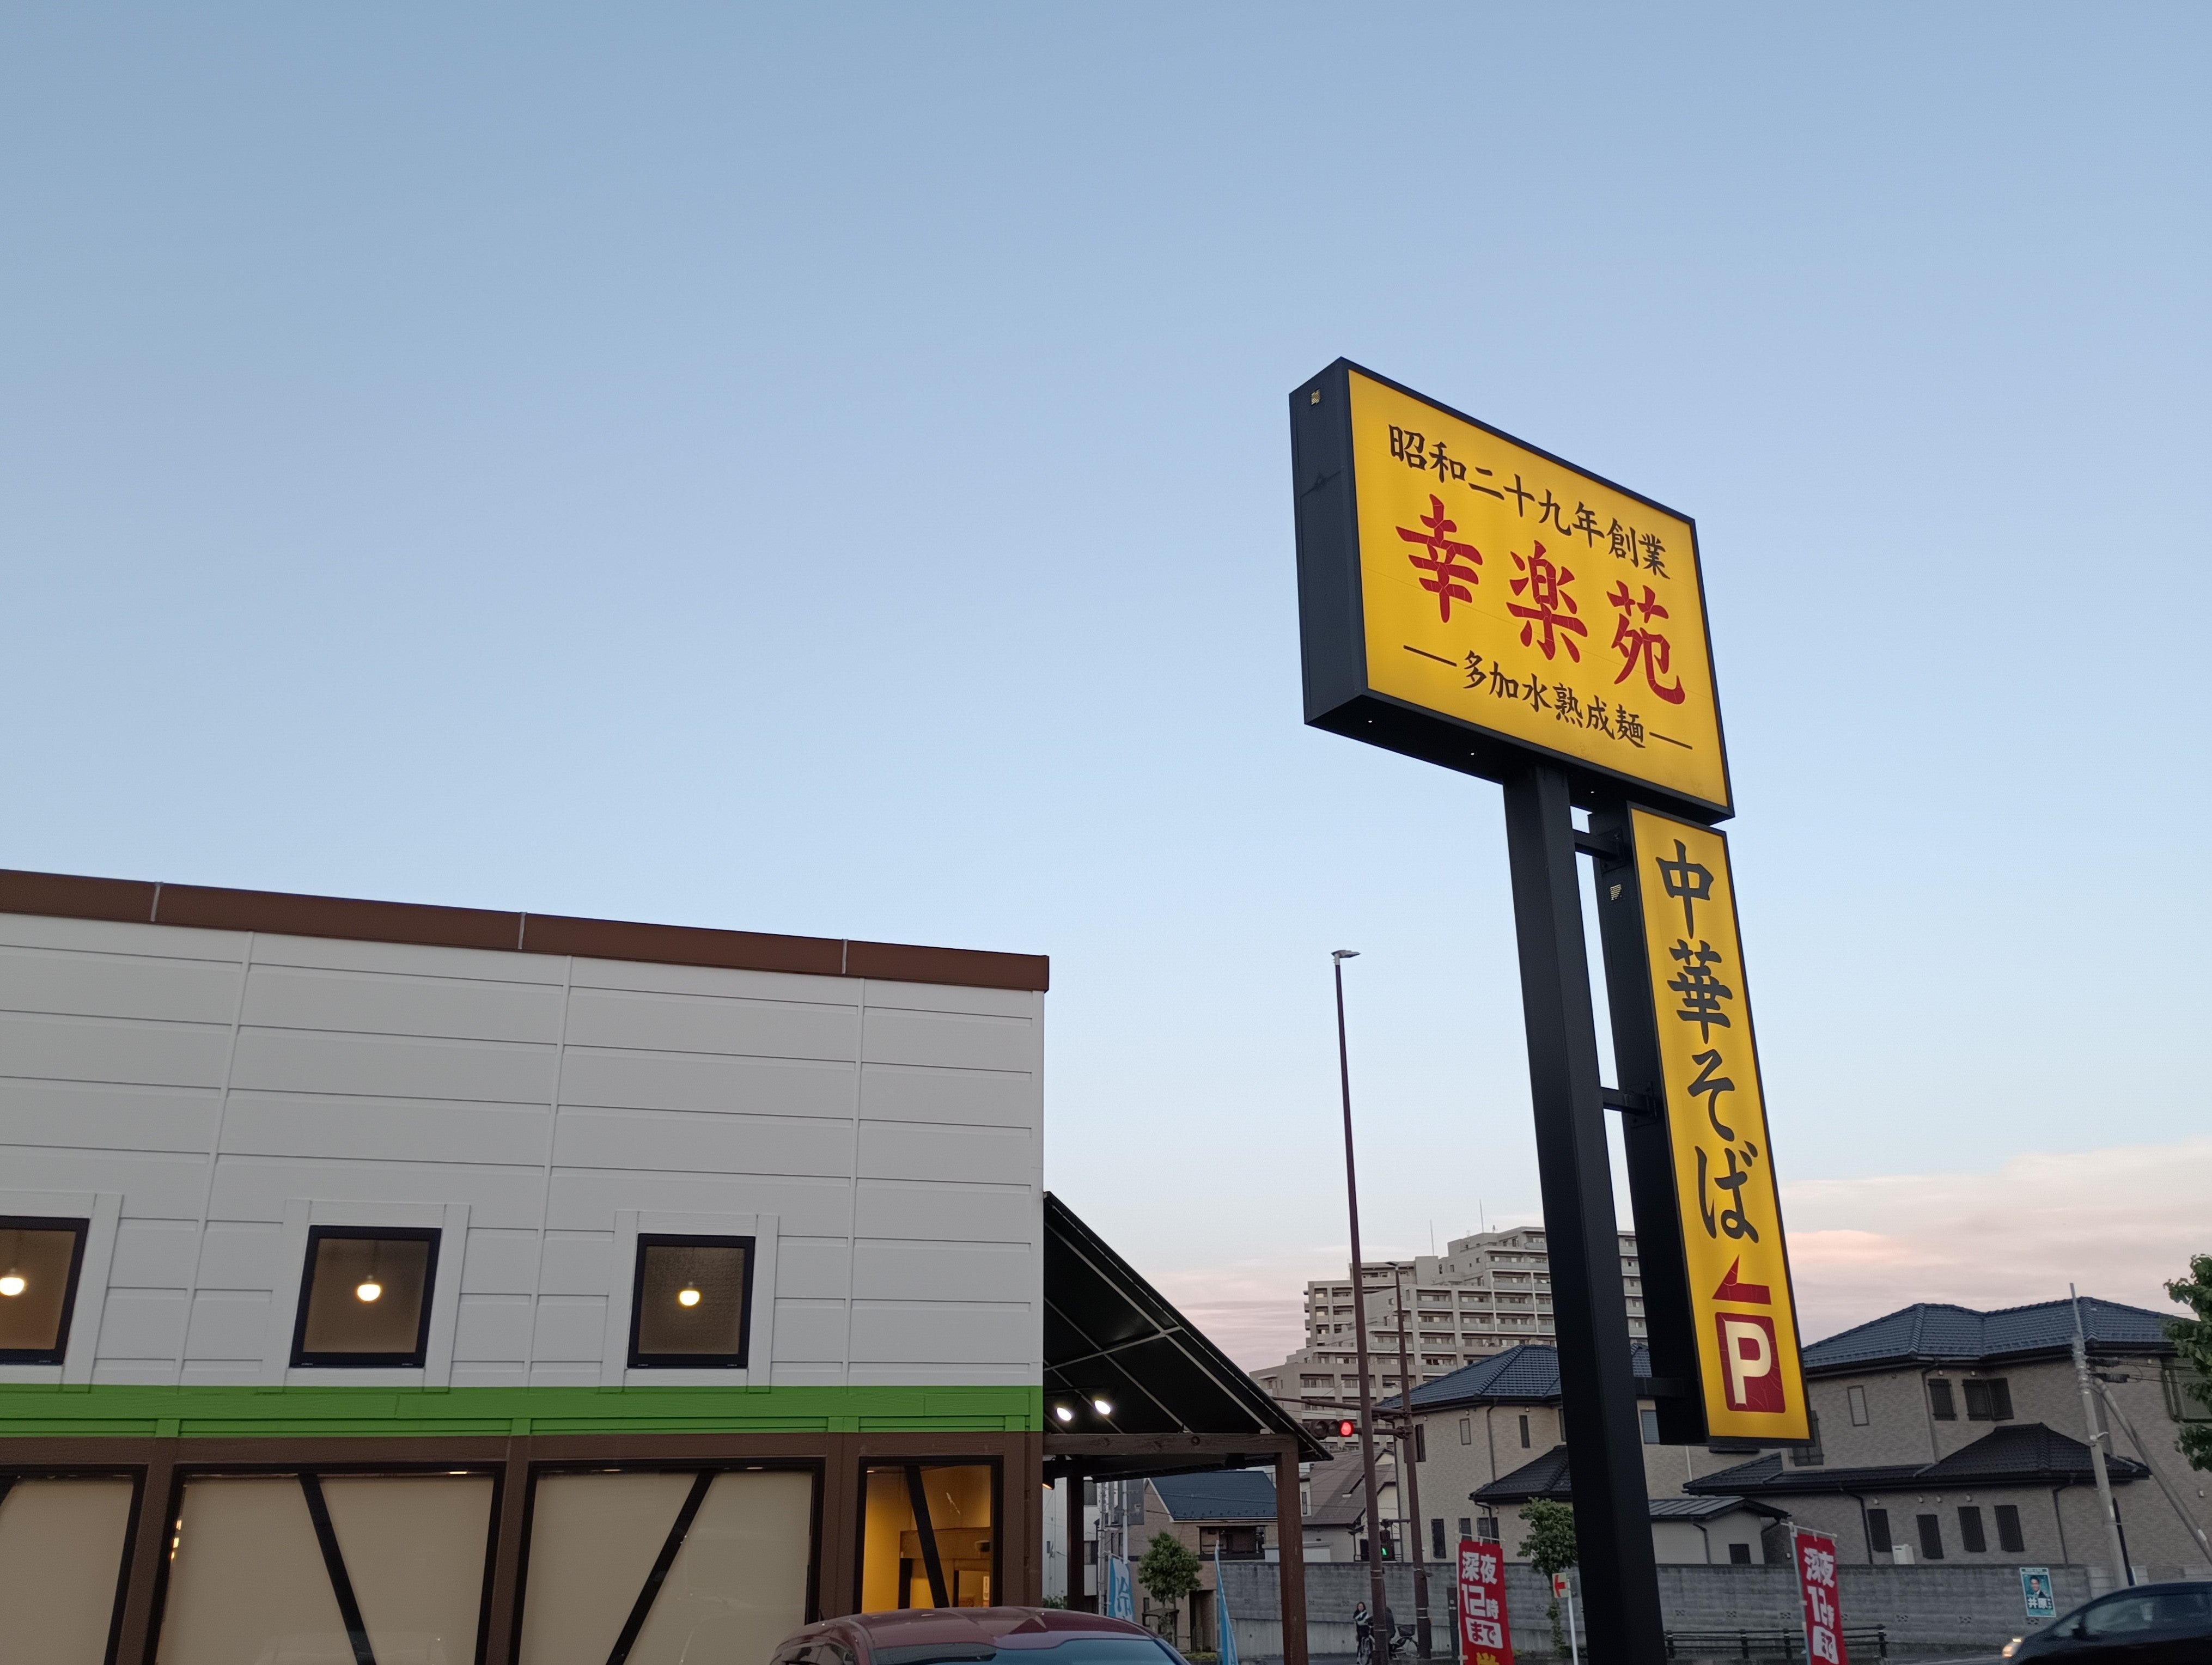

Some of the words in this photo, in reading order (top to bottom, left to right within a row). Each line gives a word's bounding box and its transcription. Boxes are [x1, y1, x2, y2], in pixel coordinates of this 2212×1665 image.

[1388, 424, 1671, 580] 昭和二十九年創業
[1396, 493, 1685, 705] 幸楽苑
[1463, 650, 1646, 749] 多加水熟成麺
[1655, 838, 1759, 1244] 中華そば
[1723, 1320, 1771, 1404] P
[1461, 1550, 1497, 1585] 深夜
[1470, 1621, 1497, 1645] まで
